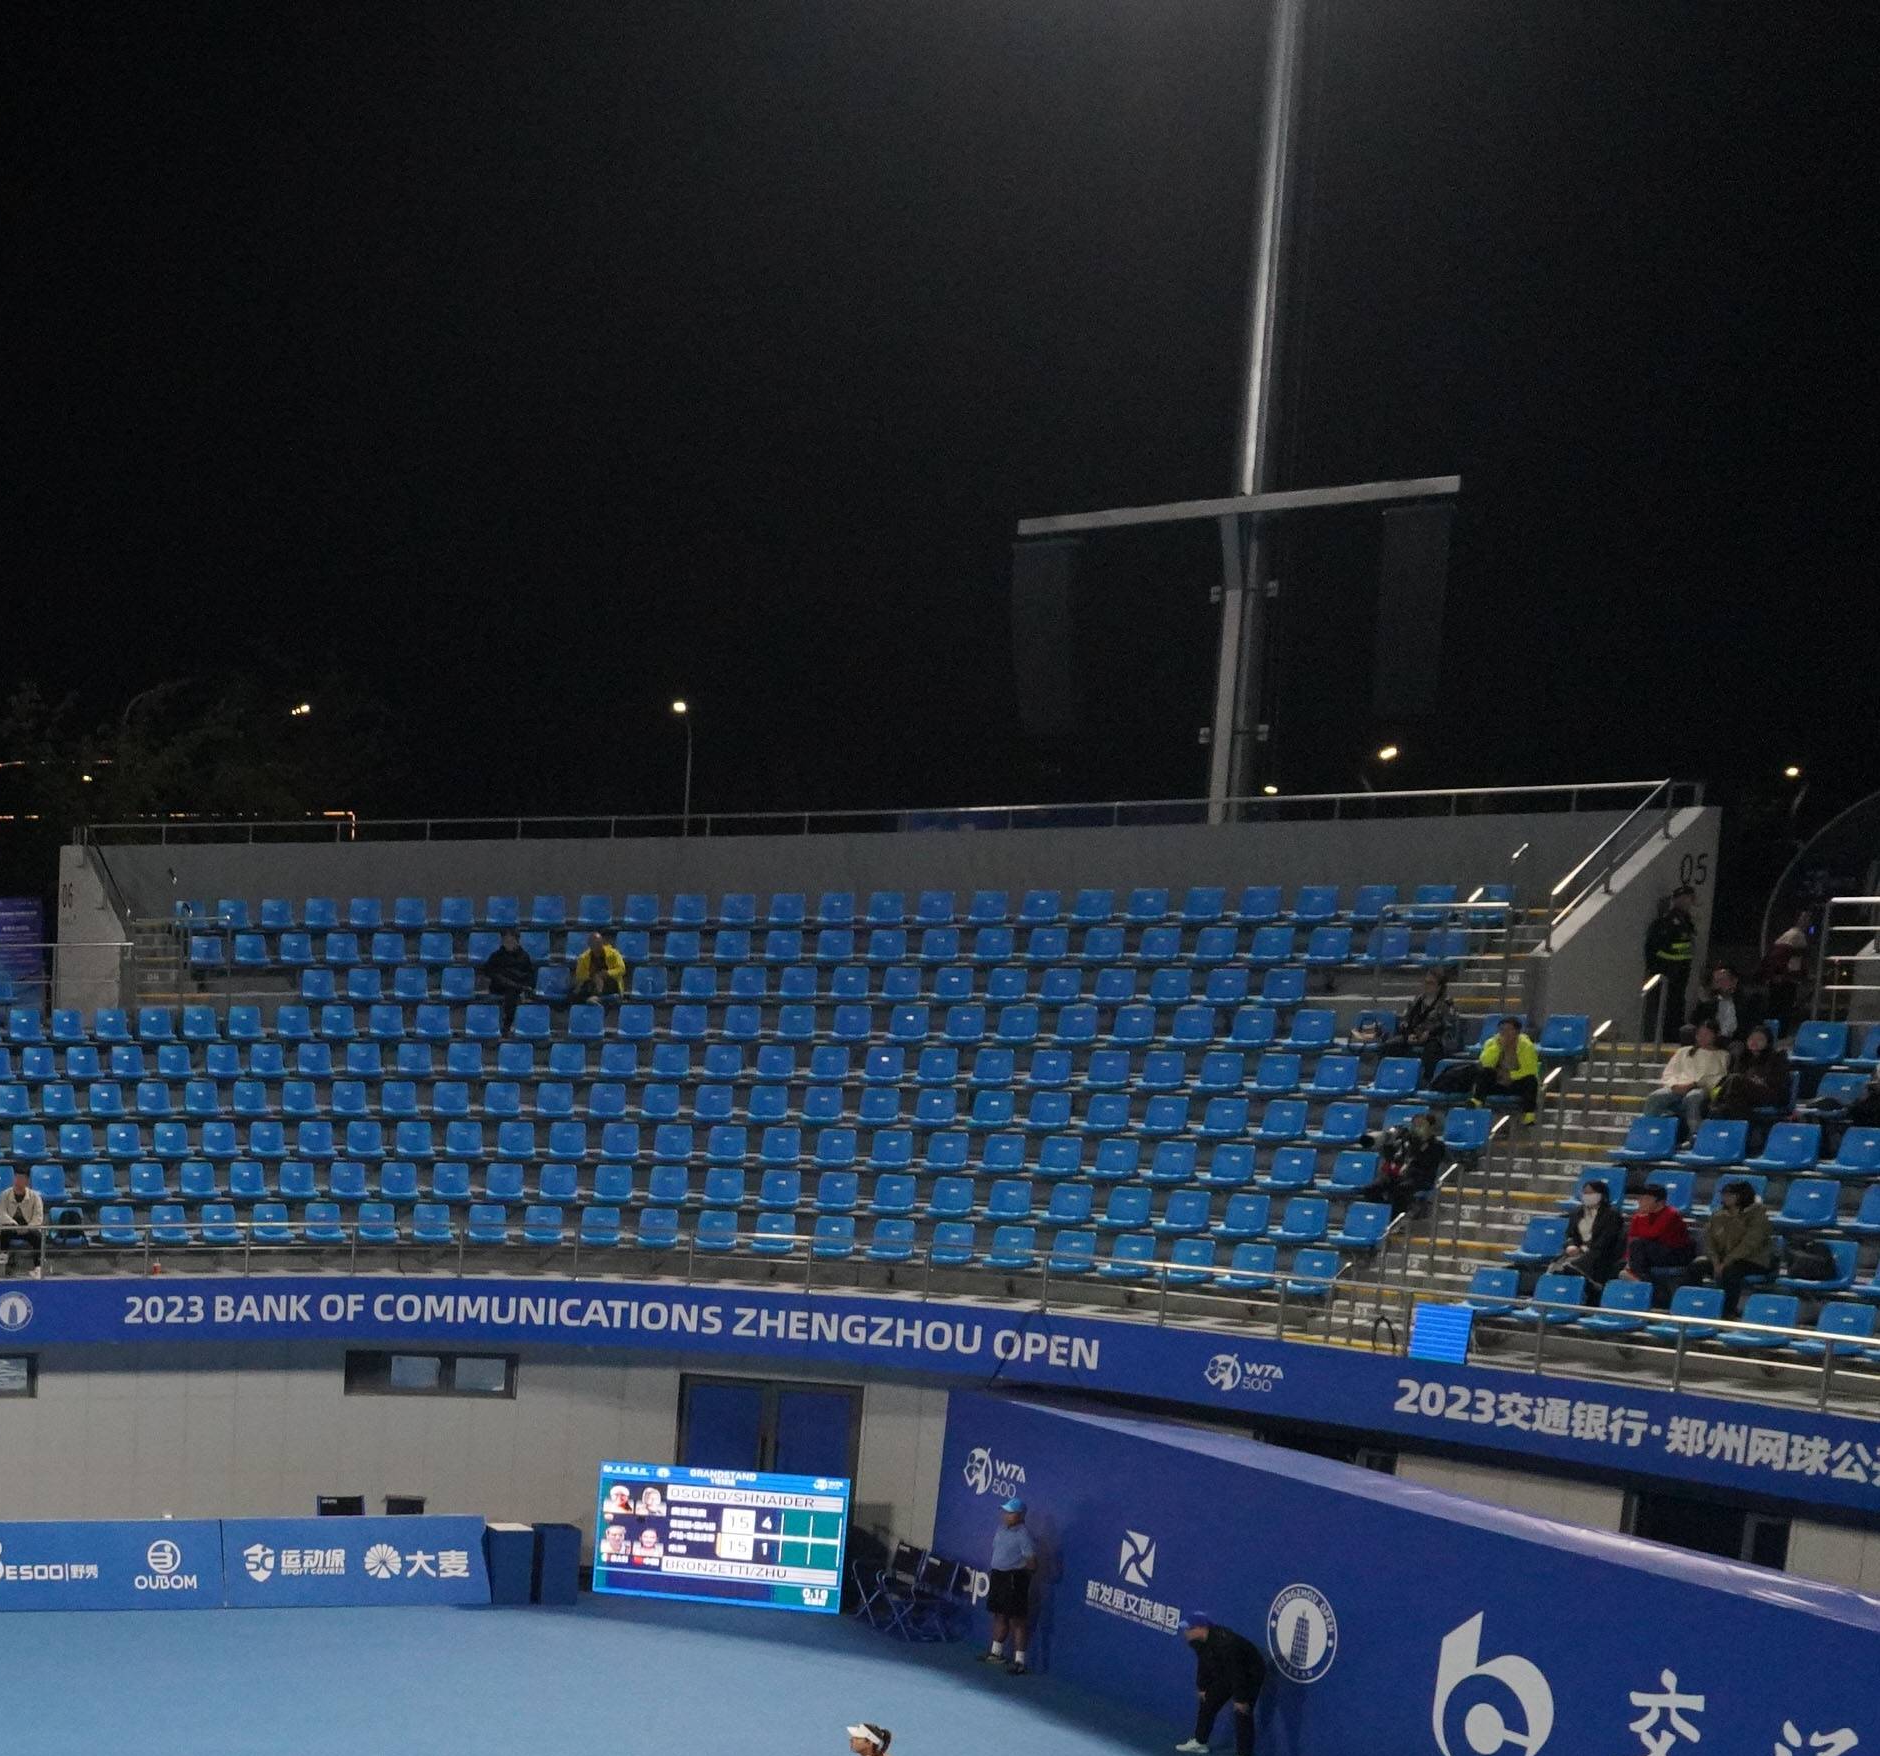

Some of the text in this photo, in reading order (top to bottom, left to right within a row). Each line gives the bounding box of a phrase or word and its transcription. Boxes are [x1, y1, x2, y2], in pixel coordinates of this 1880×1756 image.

[124, 1294, 1100, 1370] 2023 BANK OF COMMUNICATIONS ZHENGZHOU OPEN
[1244, 1360, 1286, 1380] WTA
[1242, 1377, 1273, 1393] 500
[1390, 1376, 1880, 1487] 2023交通银行·郑州网球公
[993, 1459, 1027, 1484] WTA
[669, 1487, 816, 1508] OSORIO/SHNAIDER
[992, 1478, 1017, 1499] 500
[280, 1548, 346, 1569] 运动保
[405, 1549, 470, 1578] 大麦
[664, 1558, 788, 1580] BRONZETTI/ZHU
[134, 1574, 198, 1590] OUBOM
[1085, 1579, 1181, 1629] 新发展文旅集团
